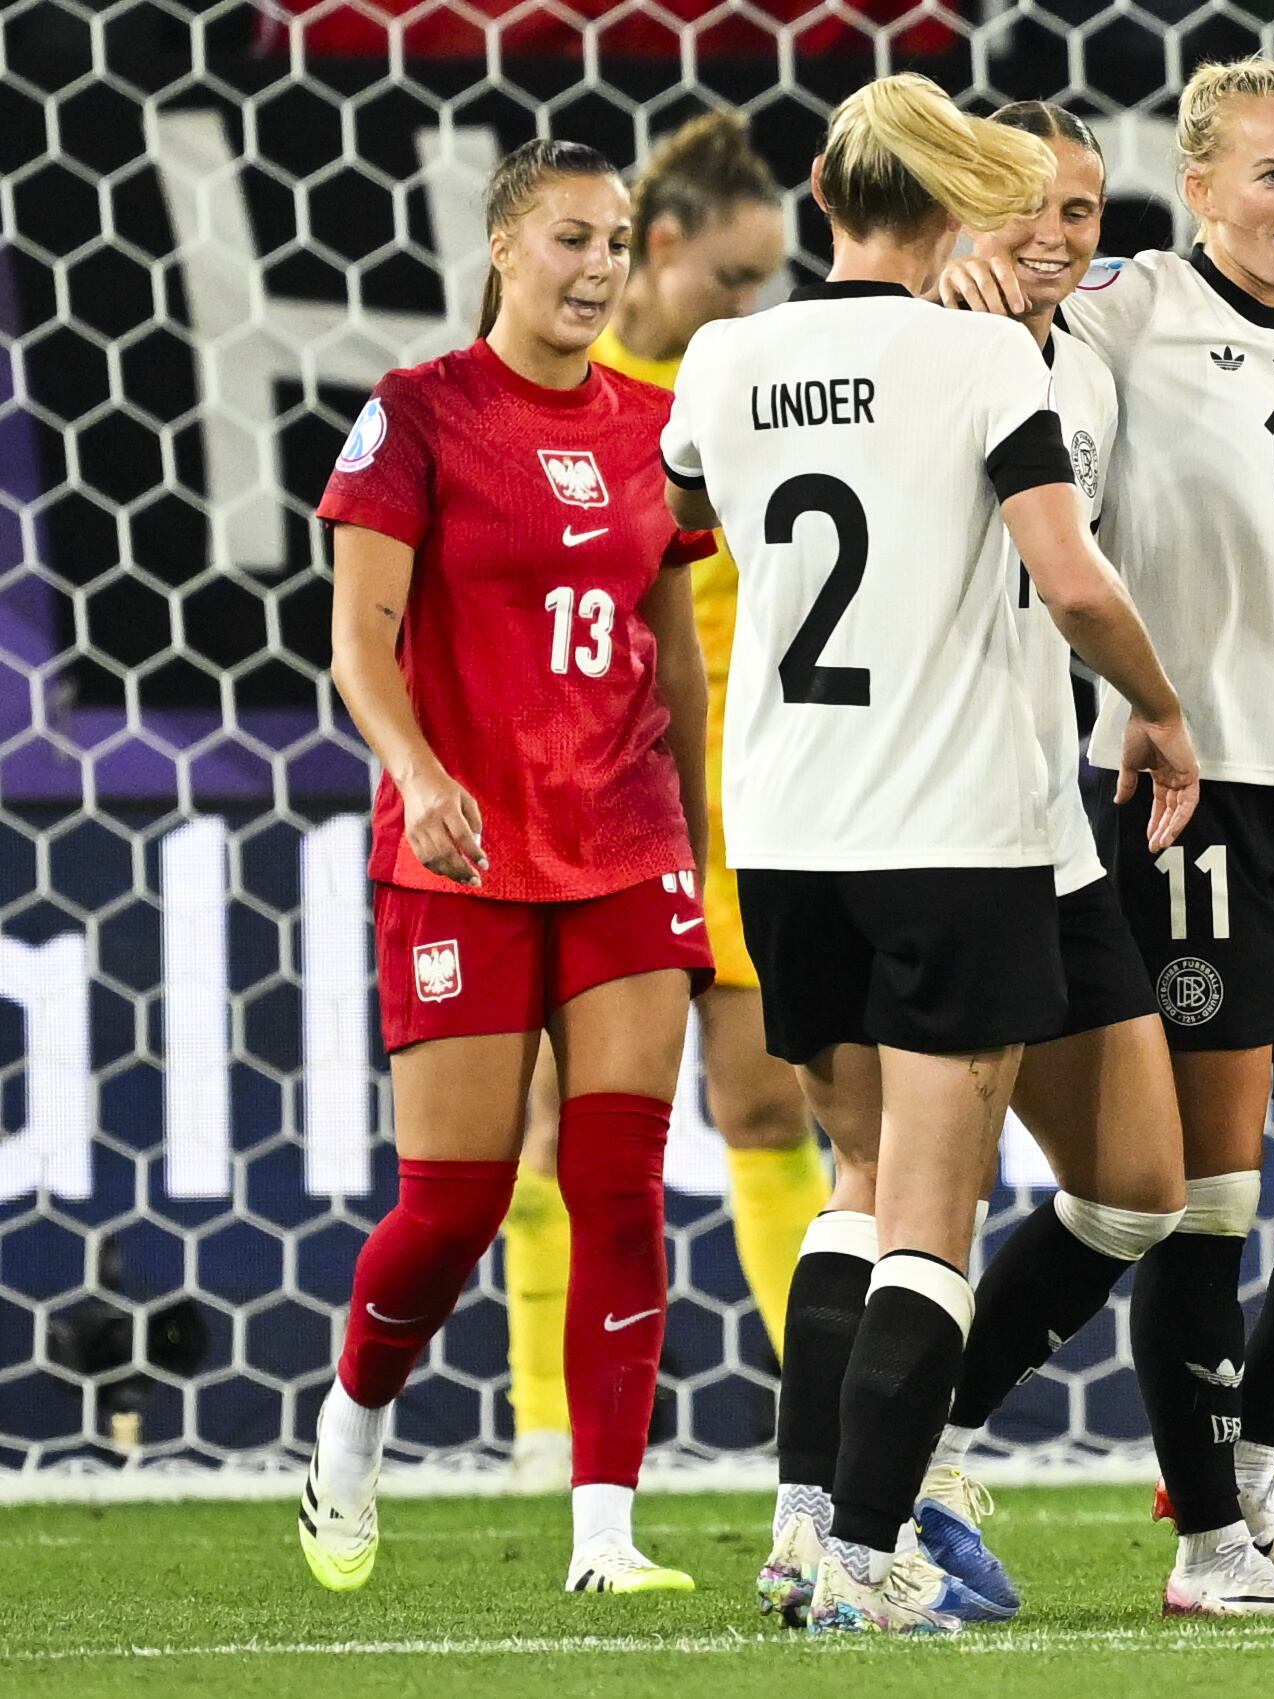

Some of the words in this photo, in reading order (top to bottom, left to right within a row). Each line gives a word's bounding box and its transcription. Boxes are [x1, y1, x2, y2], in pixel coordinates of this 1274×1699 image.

[752, 378, 875, 431] LINDER
[545, 587, 616, 678] 13
[765, 473, 871, 707] 2
[1154, 845, 1230, 940] 11
